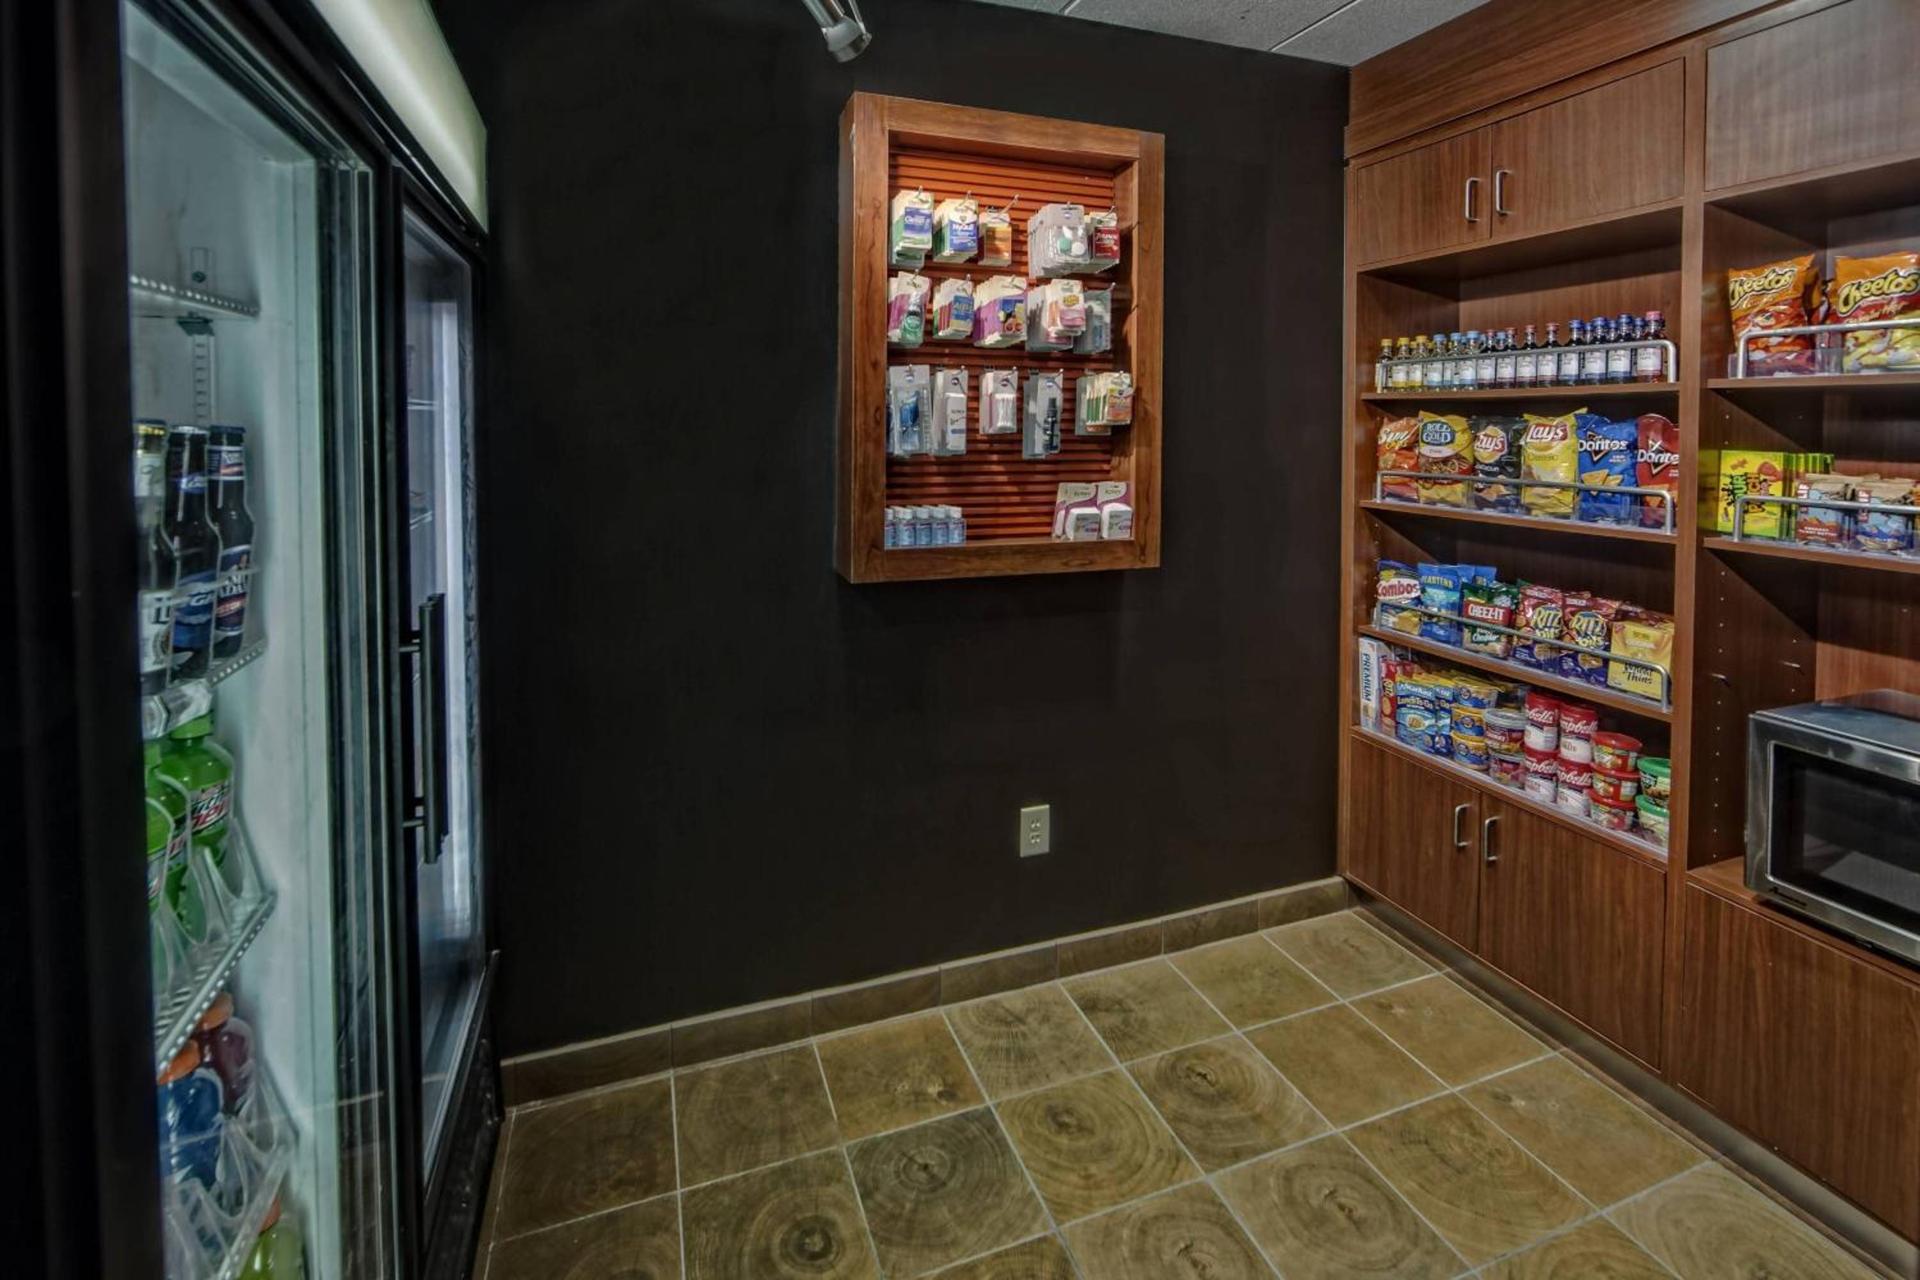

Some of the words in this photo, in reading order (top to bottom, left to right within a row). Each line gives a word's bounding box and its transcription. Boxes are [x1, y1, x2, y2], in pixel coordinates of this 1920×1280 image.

[1730, 268, 1795, 308] Cheetos
[1838, 269, 1920, 314] Cheetos
[1422, 432, 1452, 443] GOLD
[1578, 438, 1628, 452] Doritos
[1638, 449, 1680, 464] Dorito
[1731, 475, 1747, 500] OUR
[1377, 581, 1419, 597] Combos
[1467, 604, 1505, 621] CHEEZ-IT
[1531, 606, 1562, 628] RITZ
[1571, 614, 1606, 637] RITZ
[1362, 653, 1372, 702] PREMIUM
